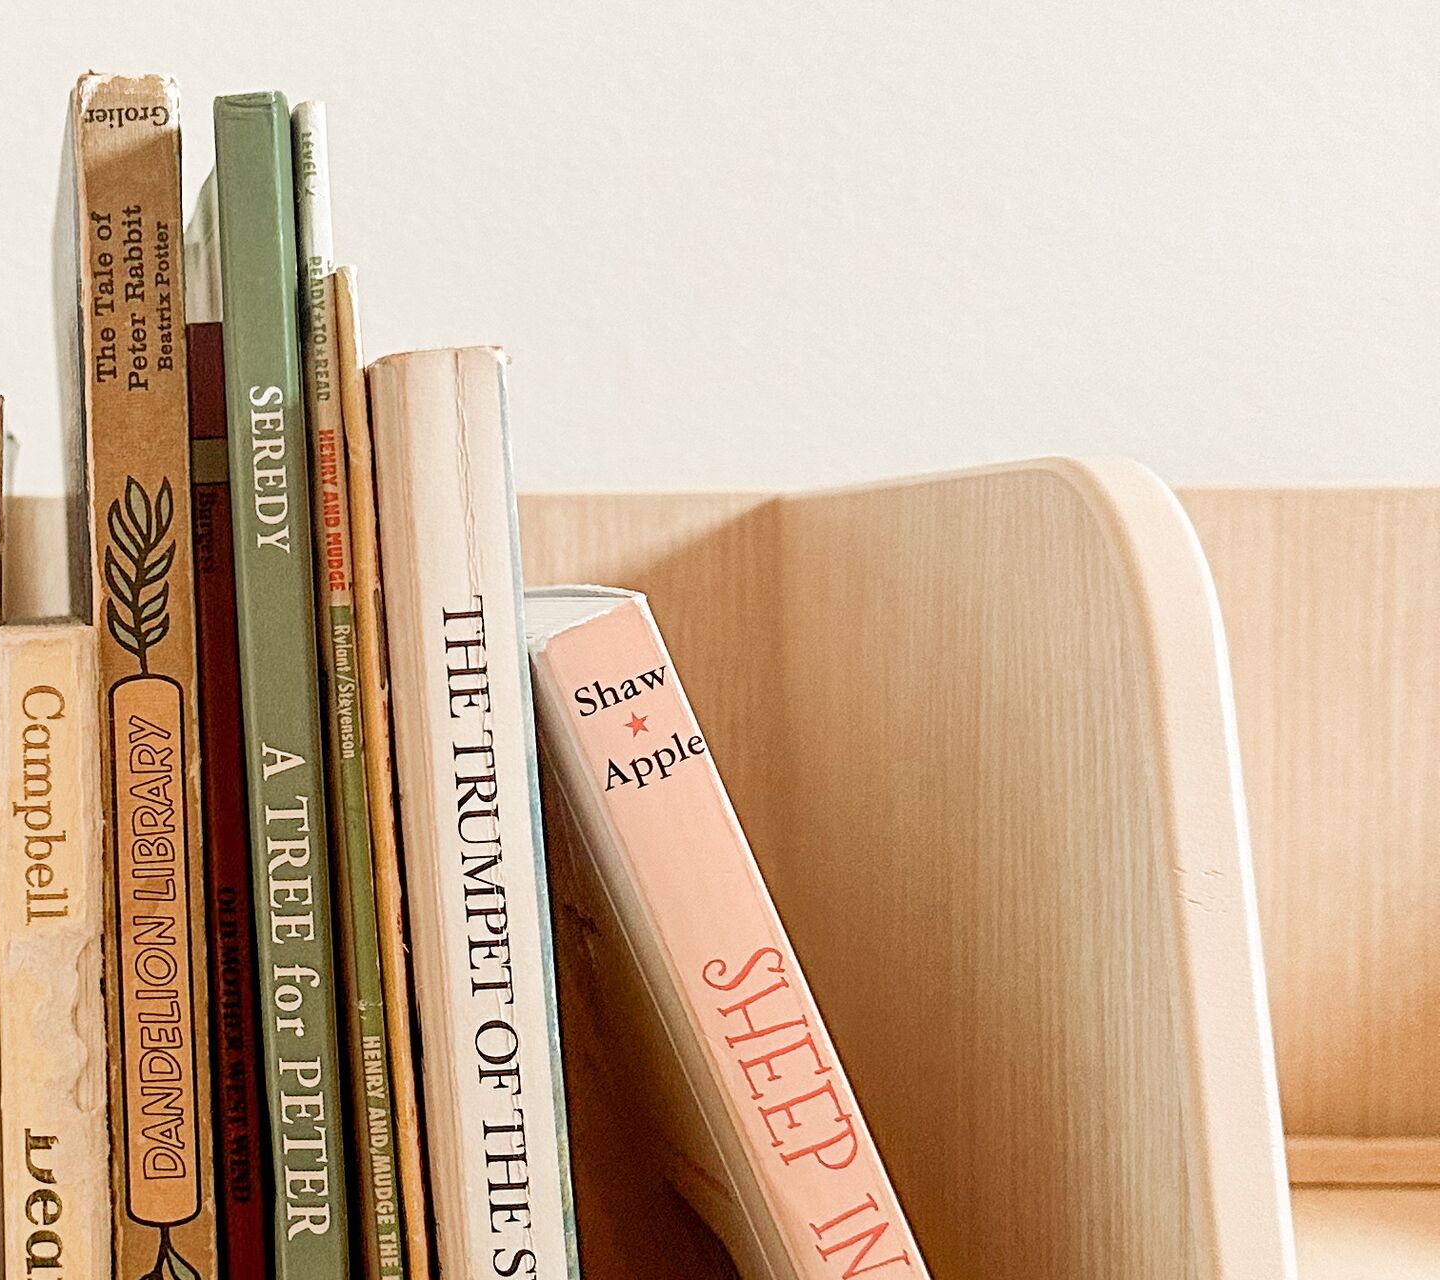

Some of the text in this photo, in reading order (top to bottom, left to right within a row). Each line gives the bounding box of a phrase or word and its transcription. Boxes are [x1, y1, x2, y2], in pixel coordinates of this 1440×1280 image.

[83, 105, 169, 129] Grolier
[90, 210, 118, 383] The Tale of
[121, 204, 149, 392] Peter Rabbit
[153, 220, 174, 372] Beatrix Potter
[248, 385, 292, 554] SEREDY
[318, 428, 346, 592] HENRY AND MUDGE
[442, 595, 491, 719] THE
[571, 660, 669, 720] Shaw
[11, 685, 69, 926] Campbell
[602, 732, 707, 793] Apple
[452, 729, 514, 1006] TRUMPET
[128, 714, 186, 1180] DANDELION LIBRARY
[262, 743, 330, 1241] A TREE for PETER
[362, 1035, 386, 1099] HENRY
[474, 1019, 525, 1097] OF
[701, 946, 857, 1172] SHEEP
[372, 1154, 397, 1225] MUDGE
[481, 1108, 533, 1234] THE
[379, 1232, 400, 1268] THE
